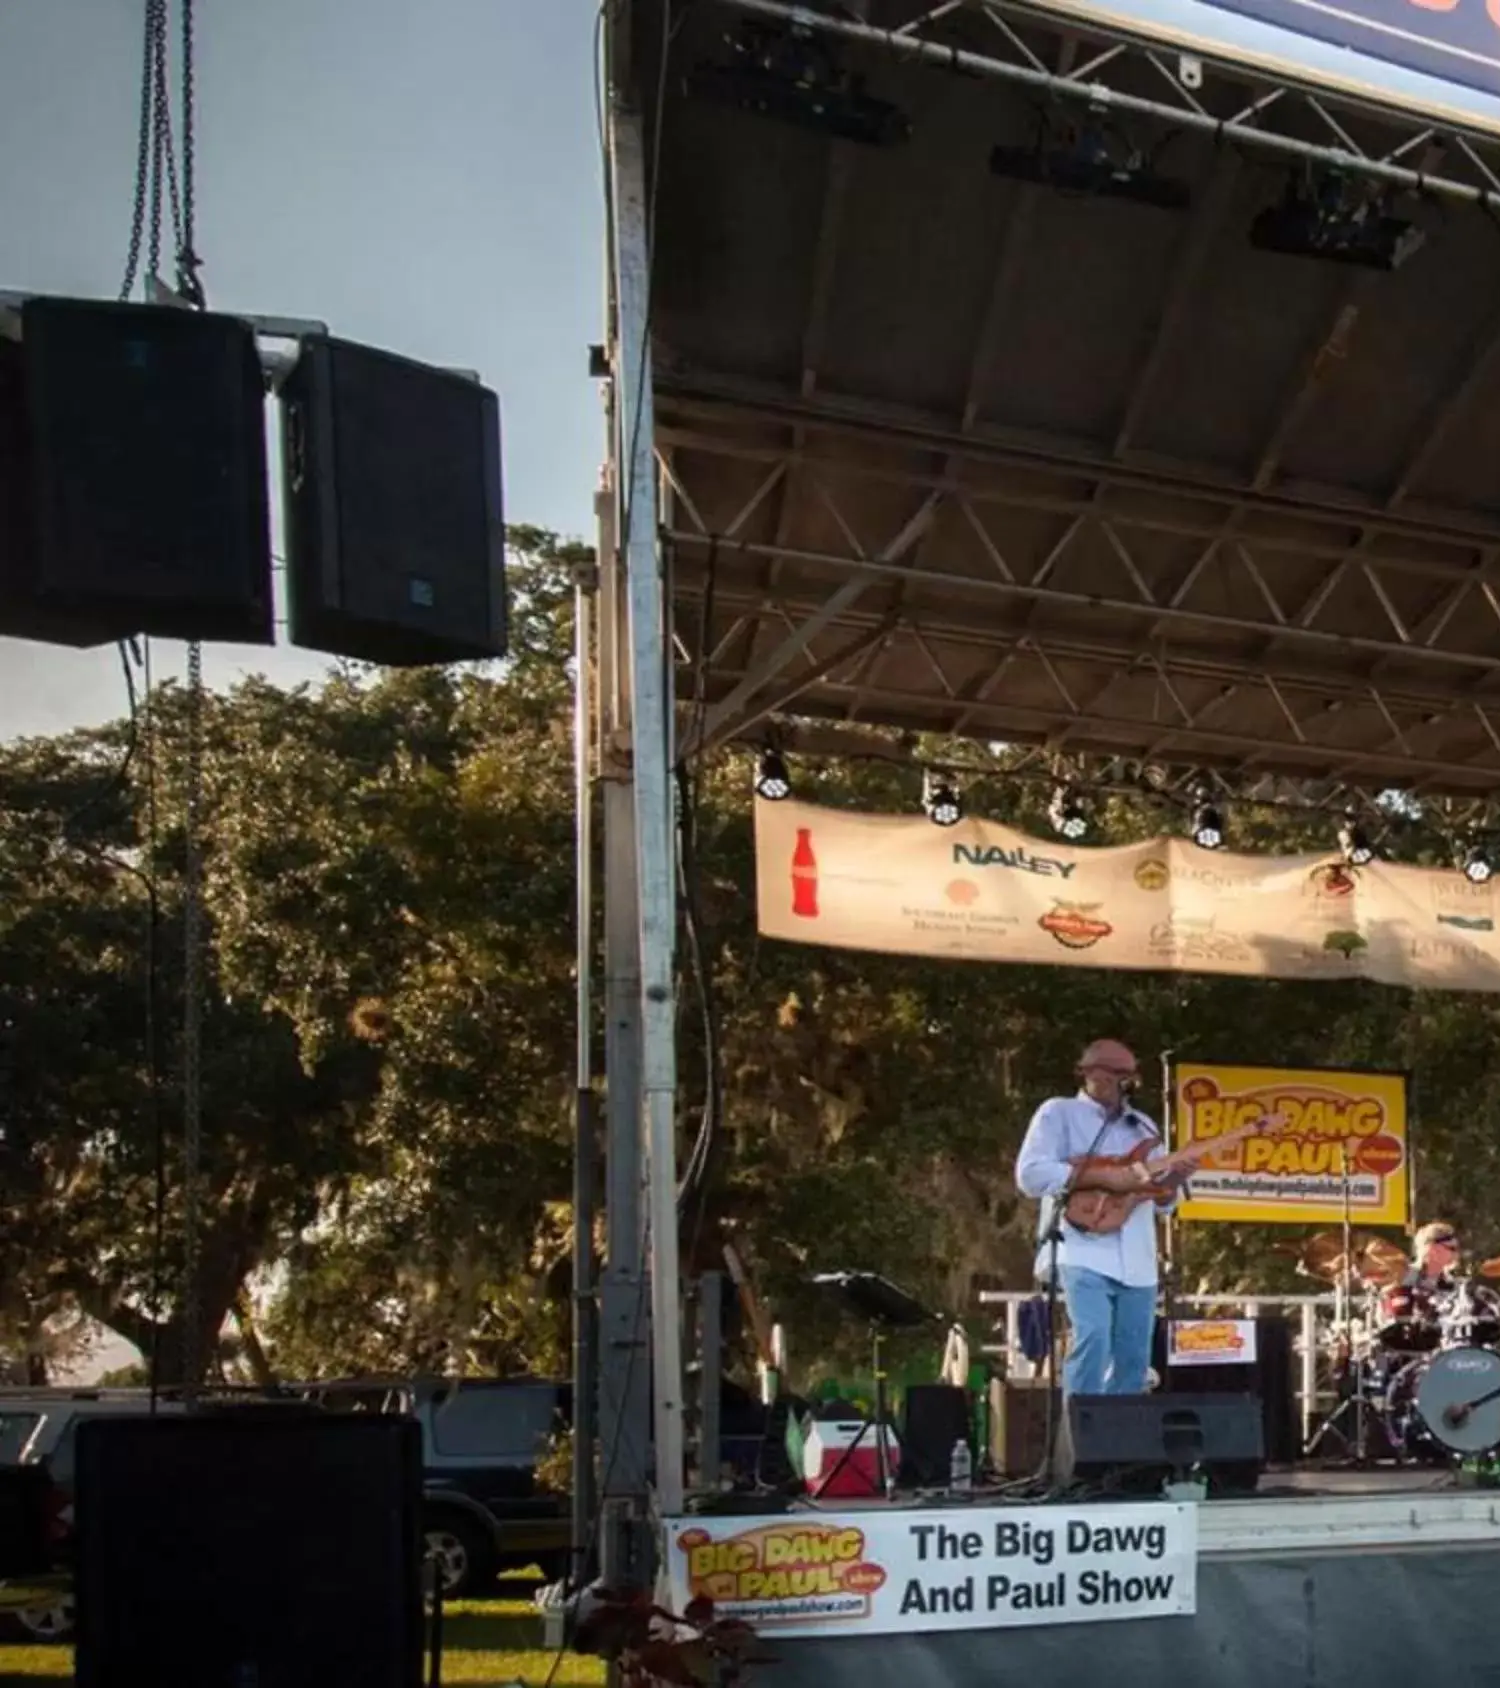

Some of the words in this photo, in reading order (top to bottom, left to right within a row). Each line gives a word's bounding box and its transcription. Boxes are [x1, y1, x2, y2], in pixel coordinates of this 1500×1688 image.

[1194, 1097, 1264, 1138] BIG
[1276, 1097, 1382, 1137] DAWG
[1245, 1137, 1357, 1173] PAUL
[691, 1543, 757, 1576] BIG
[764, 1528, 864, 1566] DAWG
[909, 1525, 984, 1562] The
[994, 1522, 1054, 1565] Big
[1065, 1518, 1166, 1562] Dawg
[738, 1566, 841, 1599] PAUL
[898, 1577, 975, 1616] And
[986, 1573, 1066, 1612] Paul
[1076, 1569, 1175, 1607] Show
